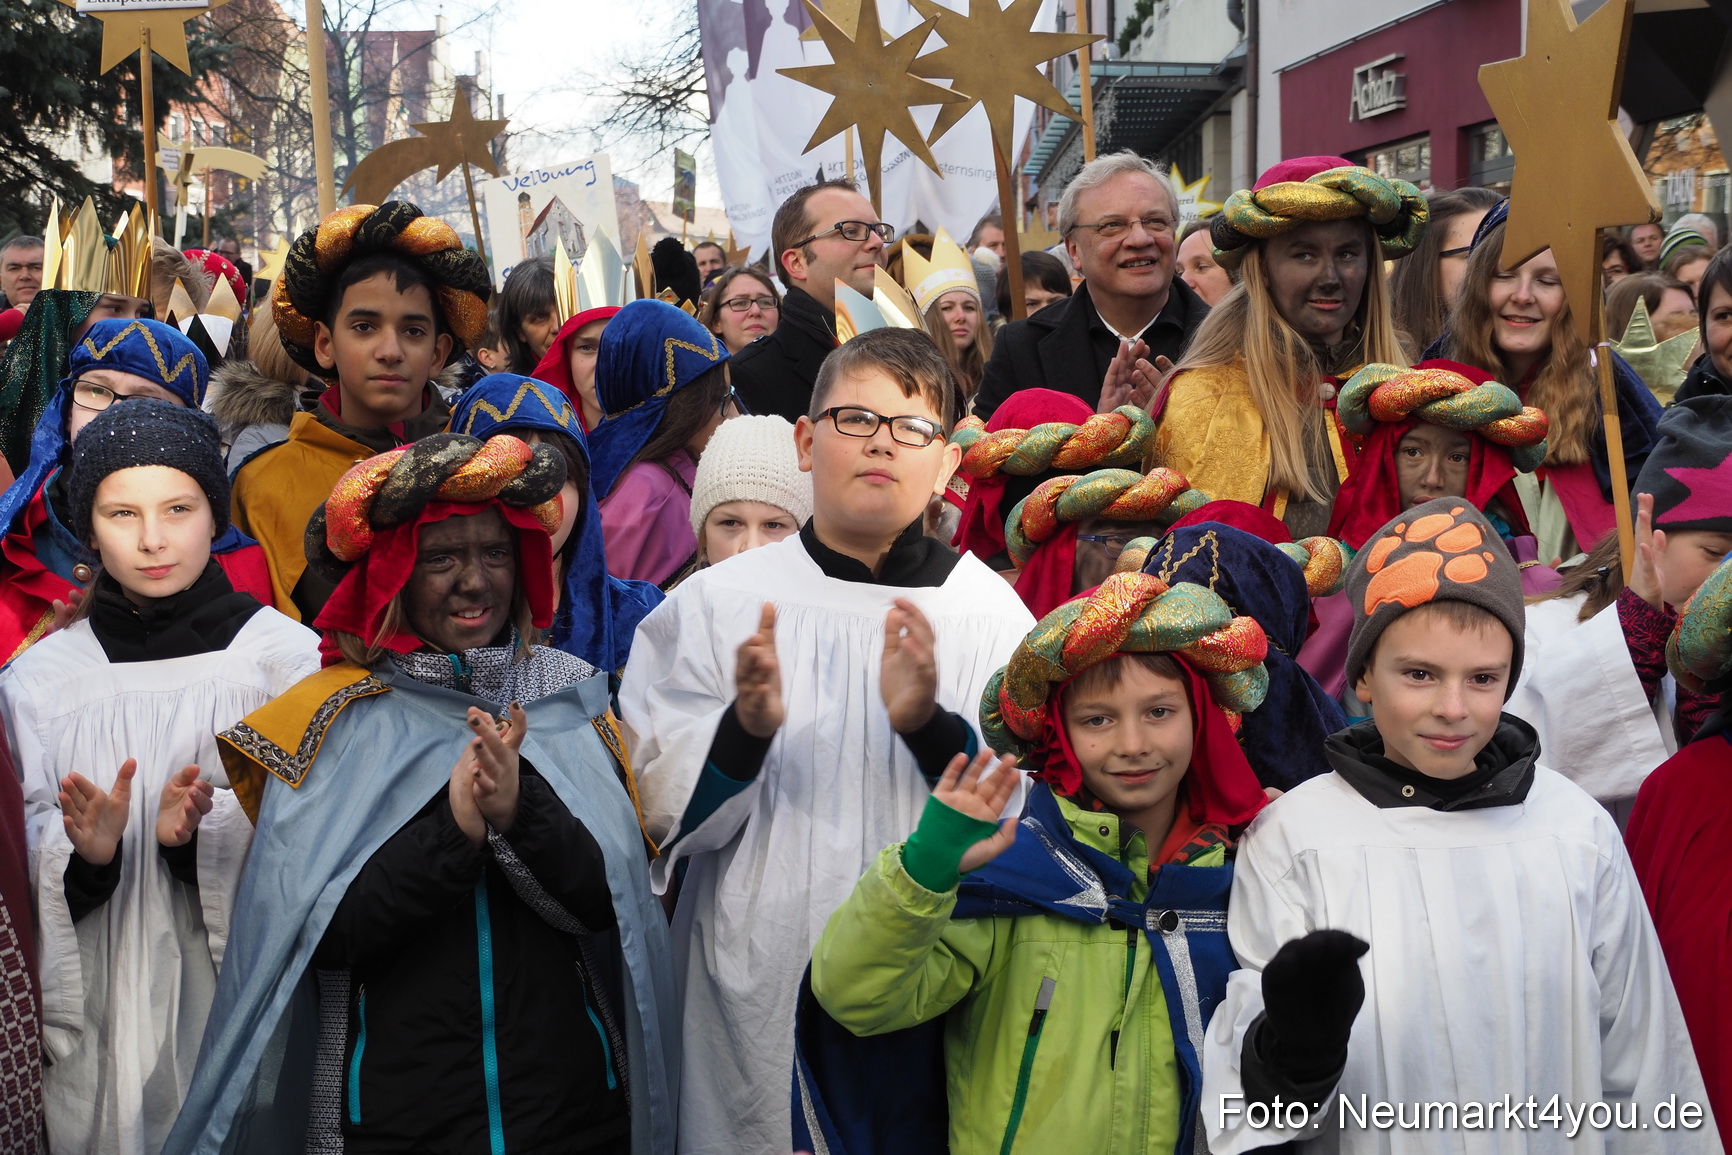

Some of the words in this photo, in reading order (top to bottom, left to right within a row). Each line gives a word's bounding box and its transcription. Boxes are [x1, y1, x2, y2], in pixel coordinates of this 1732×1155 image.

[1349, 53, 1406, 122] Achatz
[502, 160, 597, 192] Velburg
[828, 158, 865, 172] AKTON
